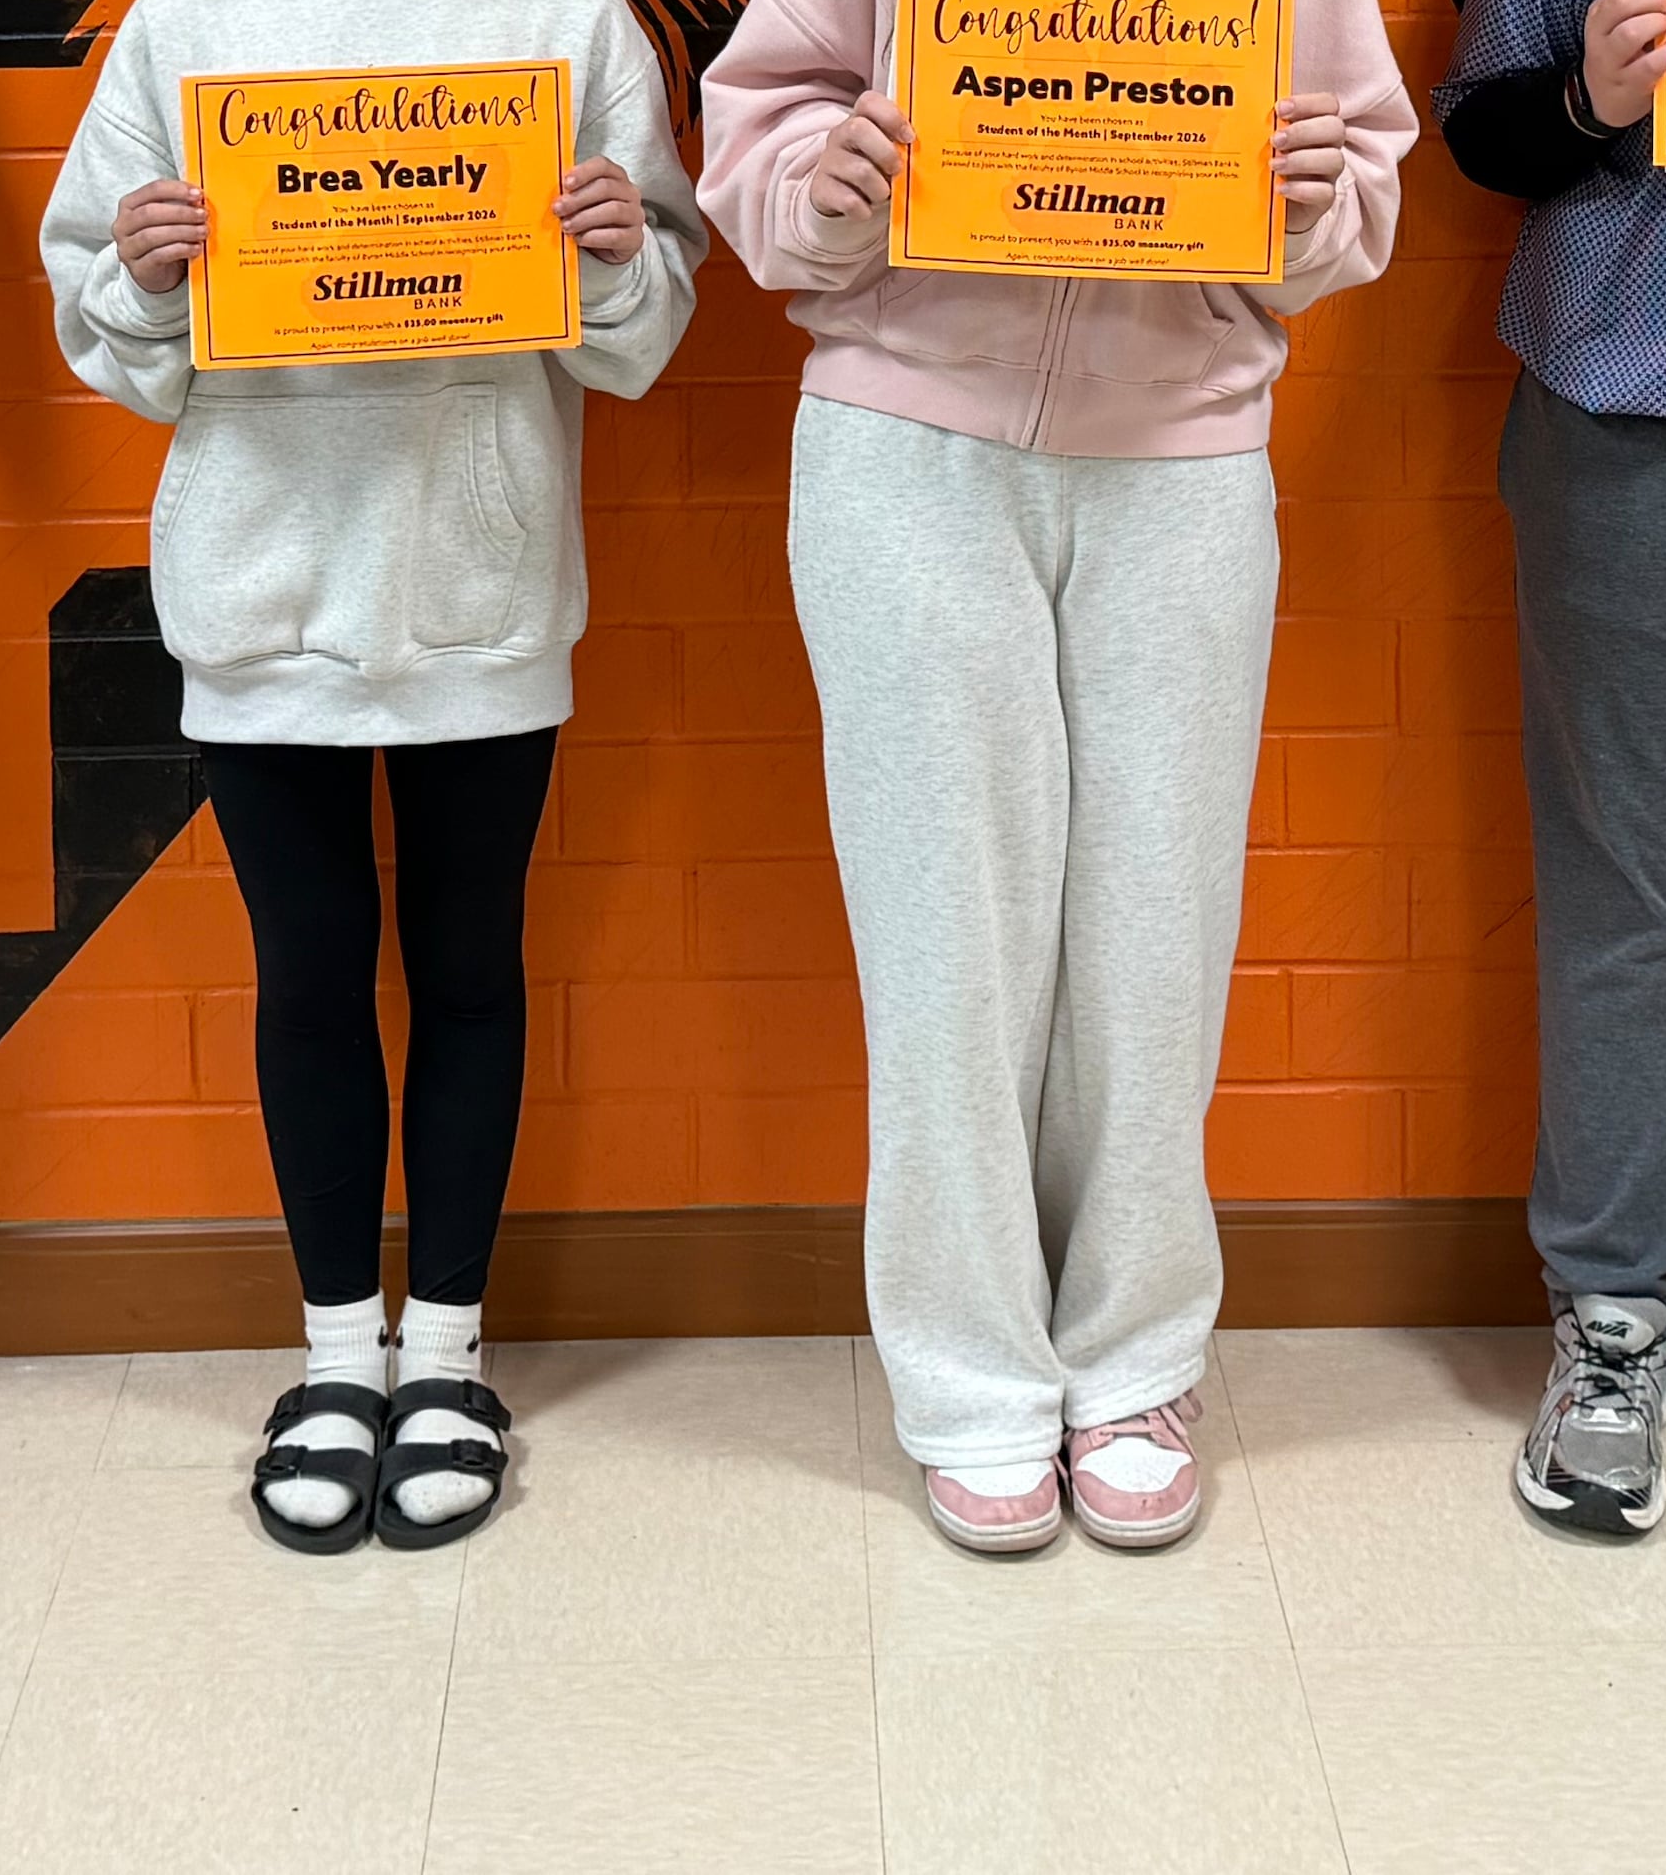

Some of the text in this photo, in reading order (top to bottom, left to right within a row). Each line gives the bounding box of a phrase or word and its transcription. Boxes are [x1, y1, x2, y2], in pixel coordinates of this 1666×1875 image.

[951, 65, 1234, 107] Aspen Preston
[218, 74, 537, 150] Congratulations!
[976, 123, 1023, 135] Student
[1025, 126, 1038, 136] of
[1040, 126, 1060, 137] the
[1062, 127, 1101, 139] Month
[1109, 129, 1173, 142] September
[1176, 132, 1206, 143] 2026
[277, 154, 487, 194] Brea Yearly
[1012, 183, 1165, 216] Stillman
[271, 219, 317, 230] Student
[319, 217, 332, 228] of
[334, 217, 354, 227] the
[356, 214, 393, 227] Month
[402, 211, 464, 226] September
[466, 209, 496, 221] 2026
[1114, 217, 1163, 231] BANK
[312, 270, 462, 301] Stillman
[413, 295, 462, 310] BANK
